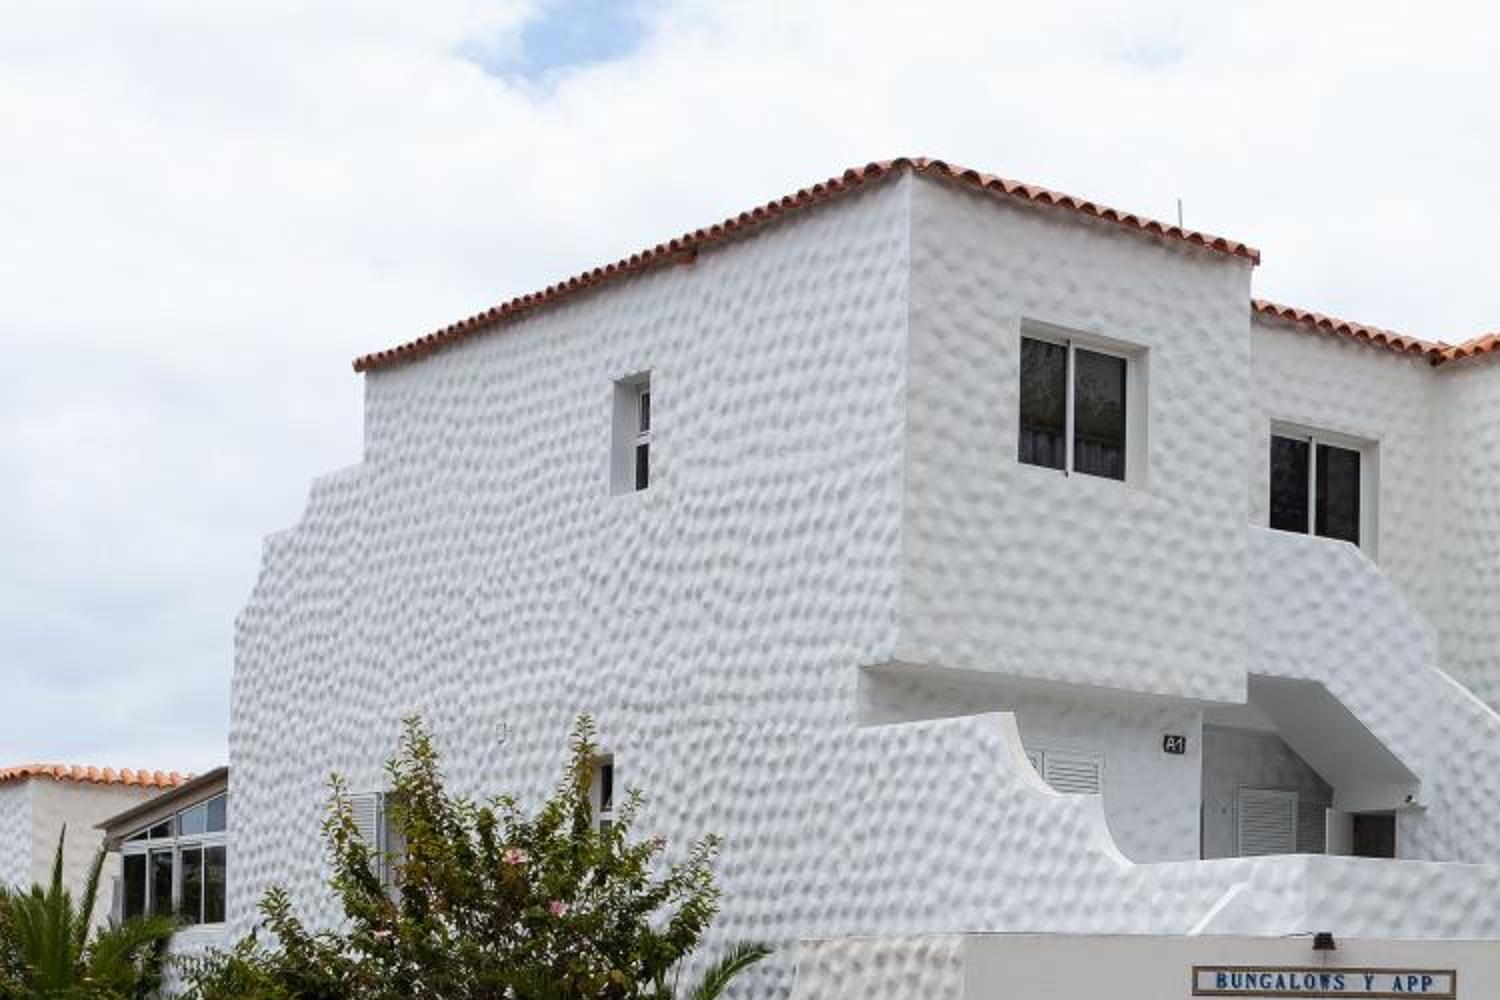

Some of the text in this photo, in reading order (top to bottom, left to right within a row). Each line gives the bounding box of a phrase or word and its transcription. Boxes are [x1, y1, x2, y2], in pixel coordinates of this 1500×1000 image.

[1166, 737, 1183, 753] A1
[1215, 973, 1434, 993] BUNGALOWS Y APP
